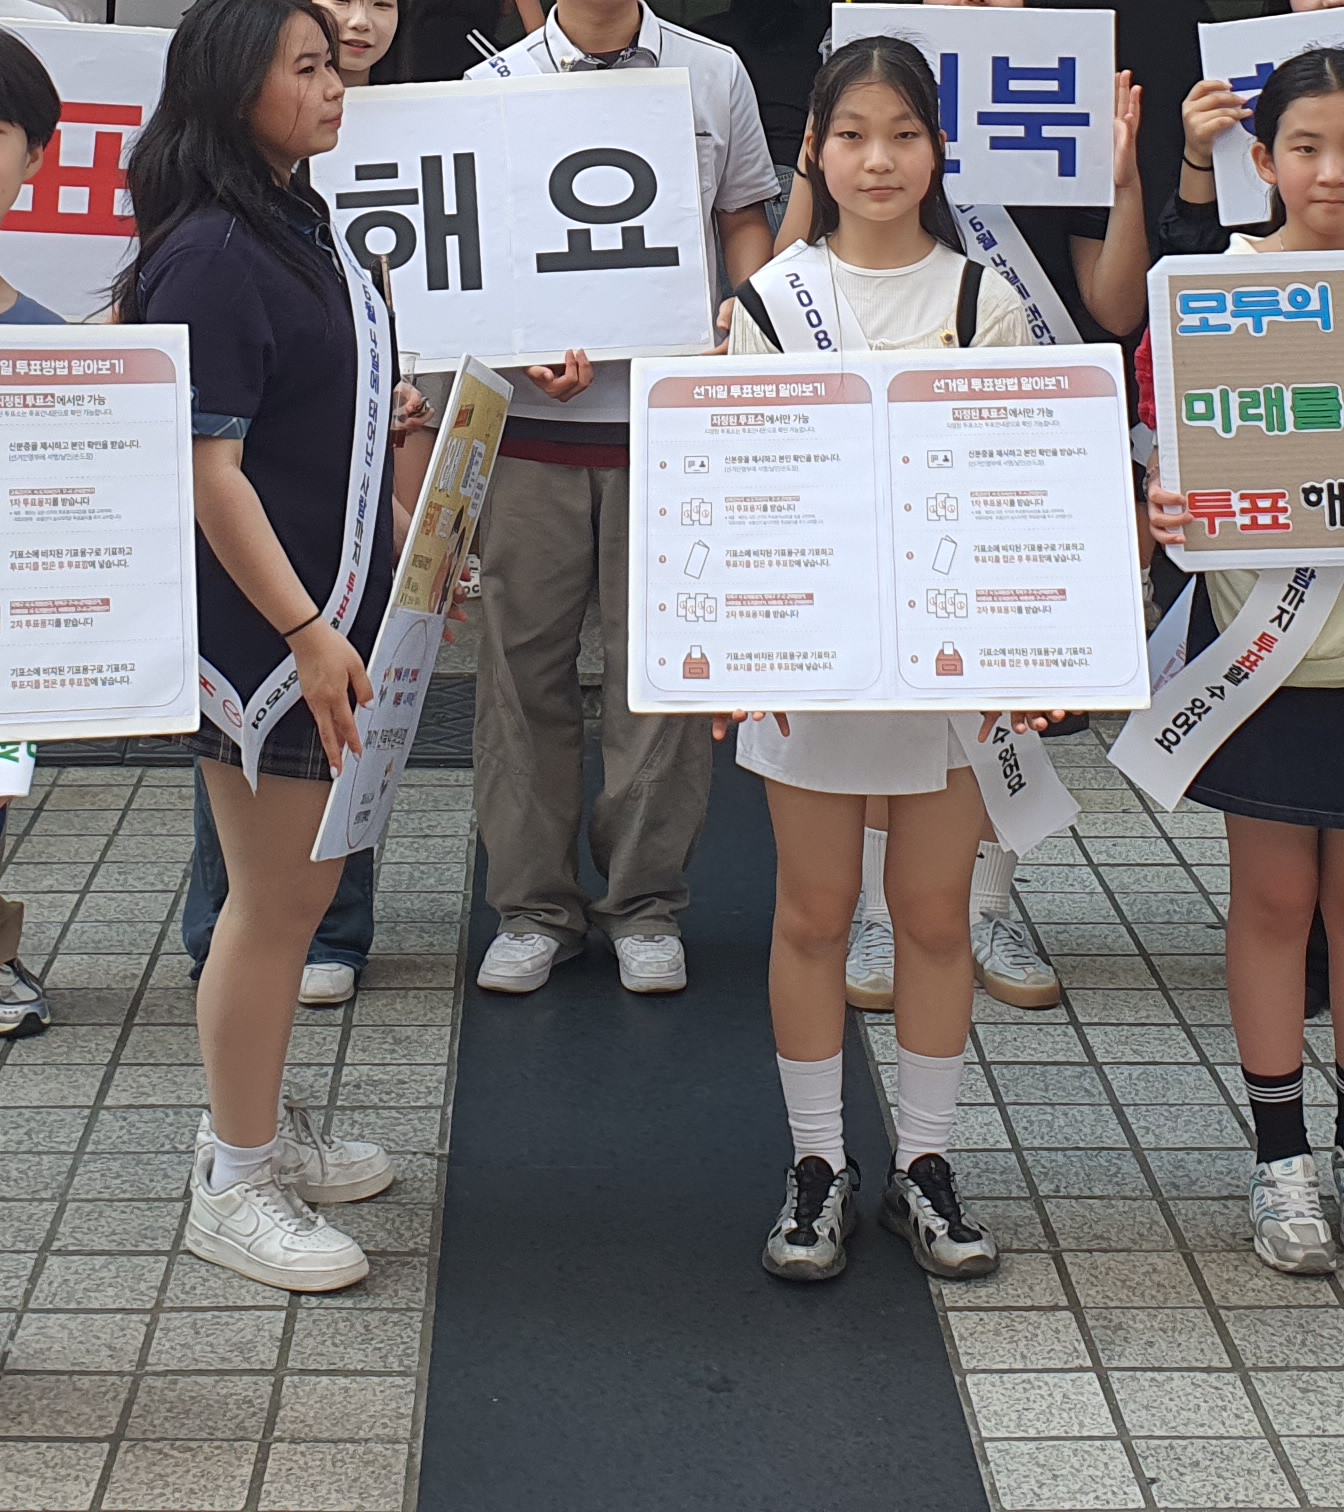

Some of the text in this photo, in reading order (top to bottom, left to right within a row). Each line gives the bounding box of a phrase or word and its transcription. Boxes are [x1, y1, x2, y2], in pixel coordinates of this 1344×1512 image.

[784, 272, 837, 353] 2008
[1178, 283, 1333, 335] 모두의
[15, 359, 68, 376] 투표방법
[71, 359, 124, 376] 알아보기
[693, 382, 826, 400] 선거일 투표방법 알아보기
[933, 375, 1069, 394] 선거일 투표방법 알아보기
[1182, 384, 1343, 435] 미래를
[1187, 489, 1292, 536] 투표
[1268, 566, 1318, 634] 람까지
[1221, 630, 1280, 689] 투표할
[1205, 683, 1228, 702] 수
[1154, 697, 1214, 755] 있어요
[991, 725, 1027, 798] 수 있어요
